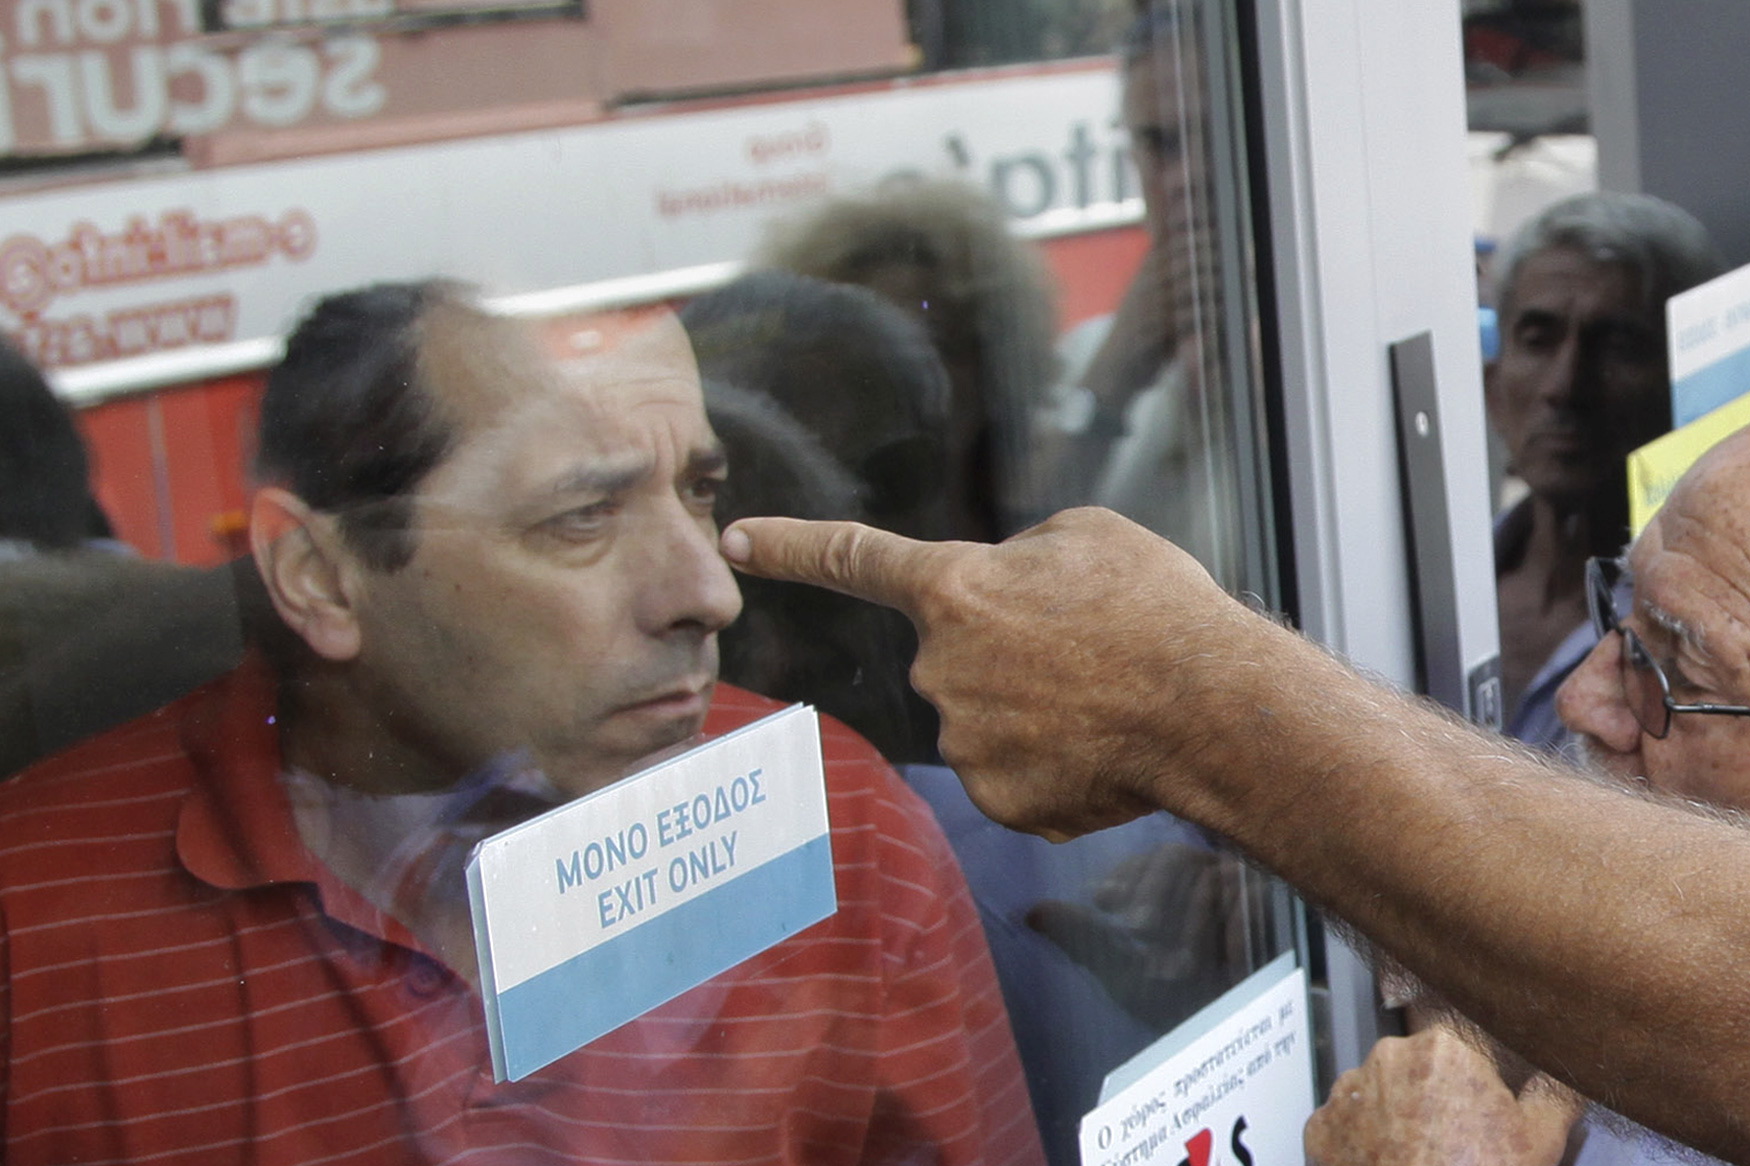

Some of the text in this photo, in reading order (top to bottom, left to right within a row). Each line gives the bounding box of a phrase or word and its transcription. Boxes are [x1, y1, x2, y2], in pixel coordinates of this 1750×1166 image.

[555, 768, 767, 895] ΜΟΝΟ ΕΞΟΔΟΣ
[597, 830, 738, 930] EXIT ONLY
